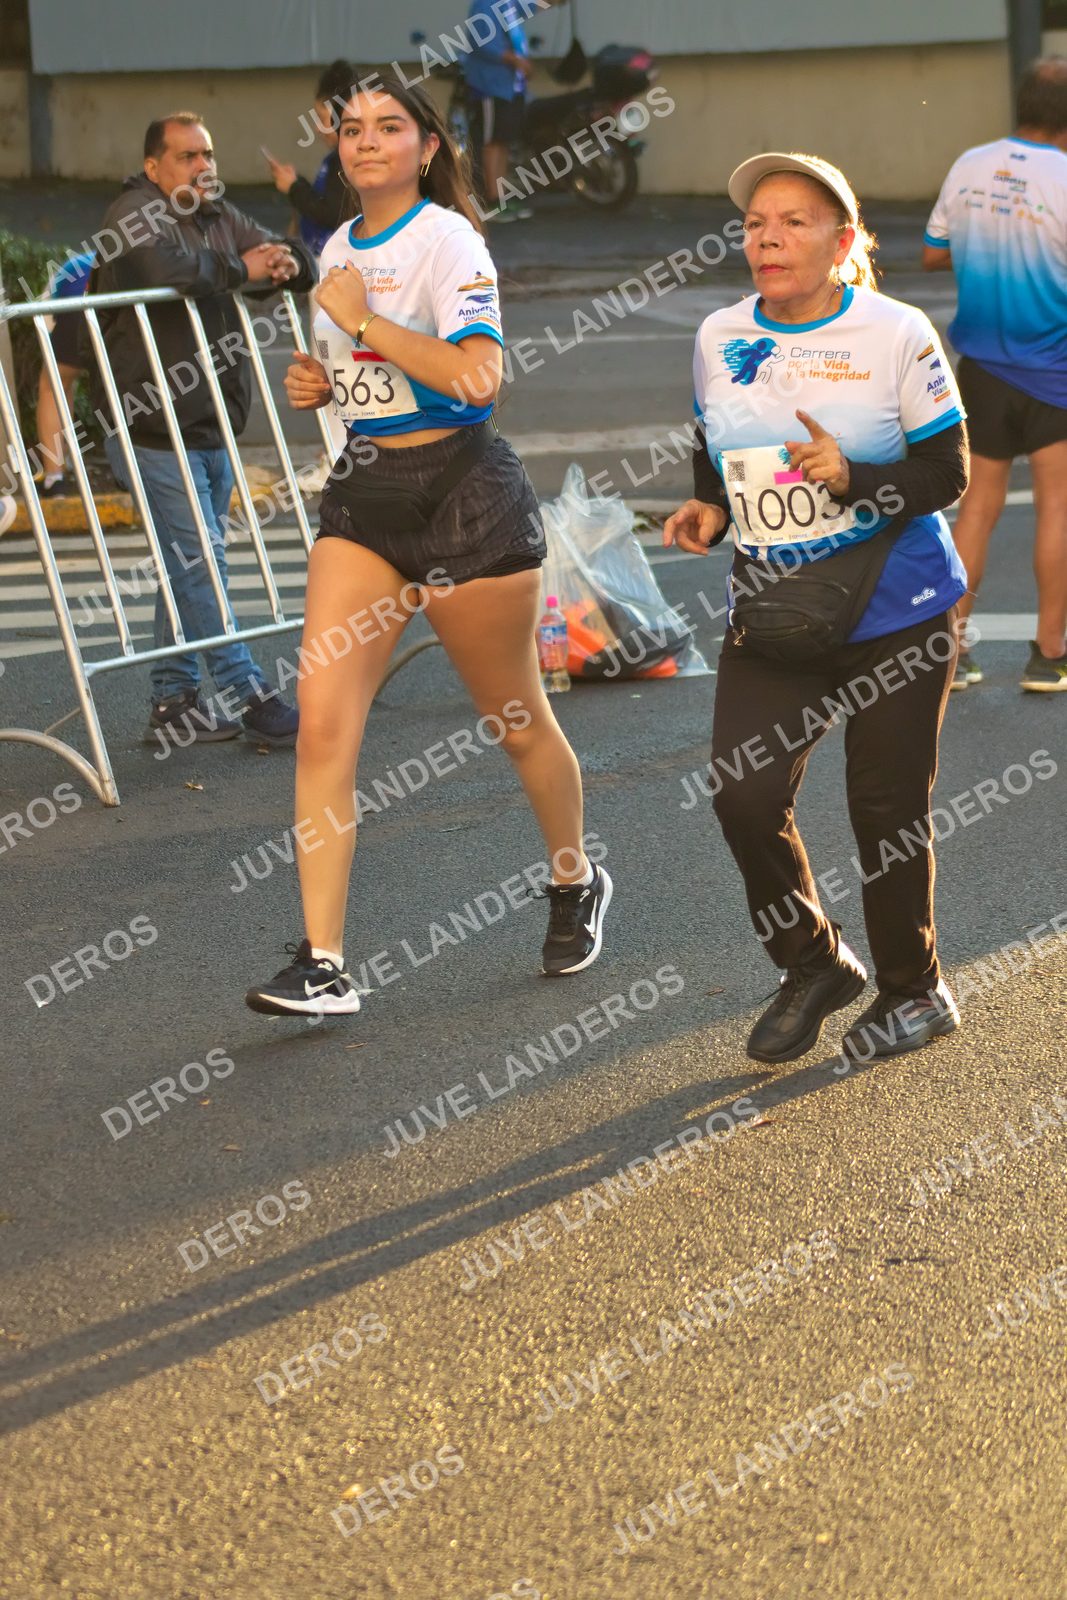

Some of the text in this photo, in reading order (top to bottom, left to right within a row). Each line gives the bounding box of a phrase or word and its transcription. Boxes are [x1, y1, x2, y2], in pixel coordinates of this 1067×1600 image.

[790, 347, 851, 360] Carrera
[824, 360, 850, 370] Vida
[809, 370, 871, 382] Integridad
[333, 366, 395, 408] 563
[734, 483, 846, 532] 1003
